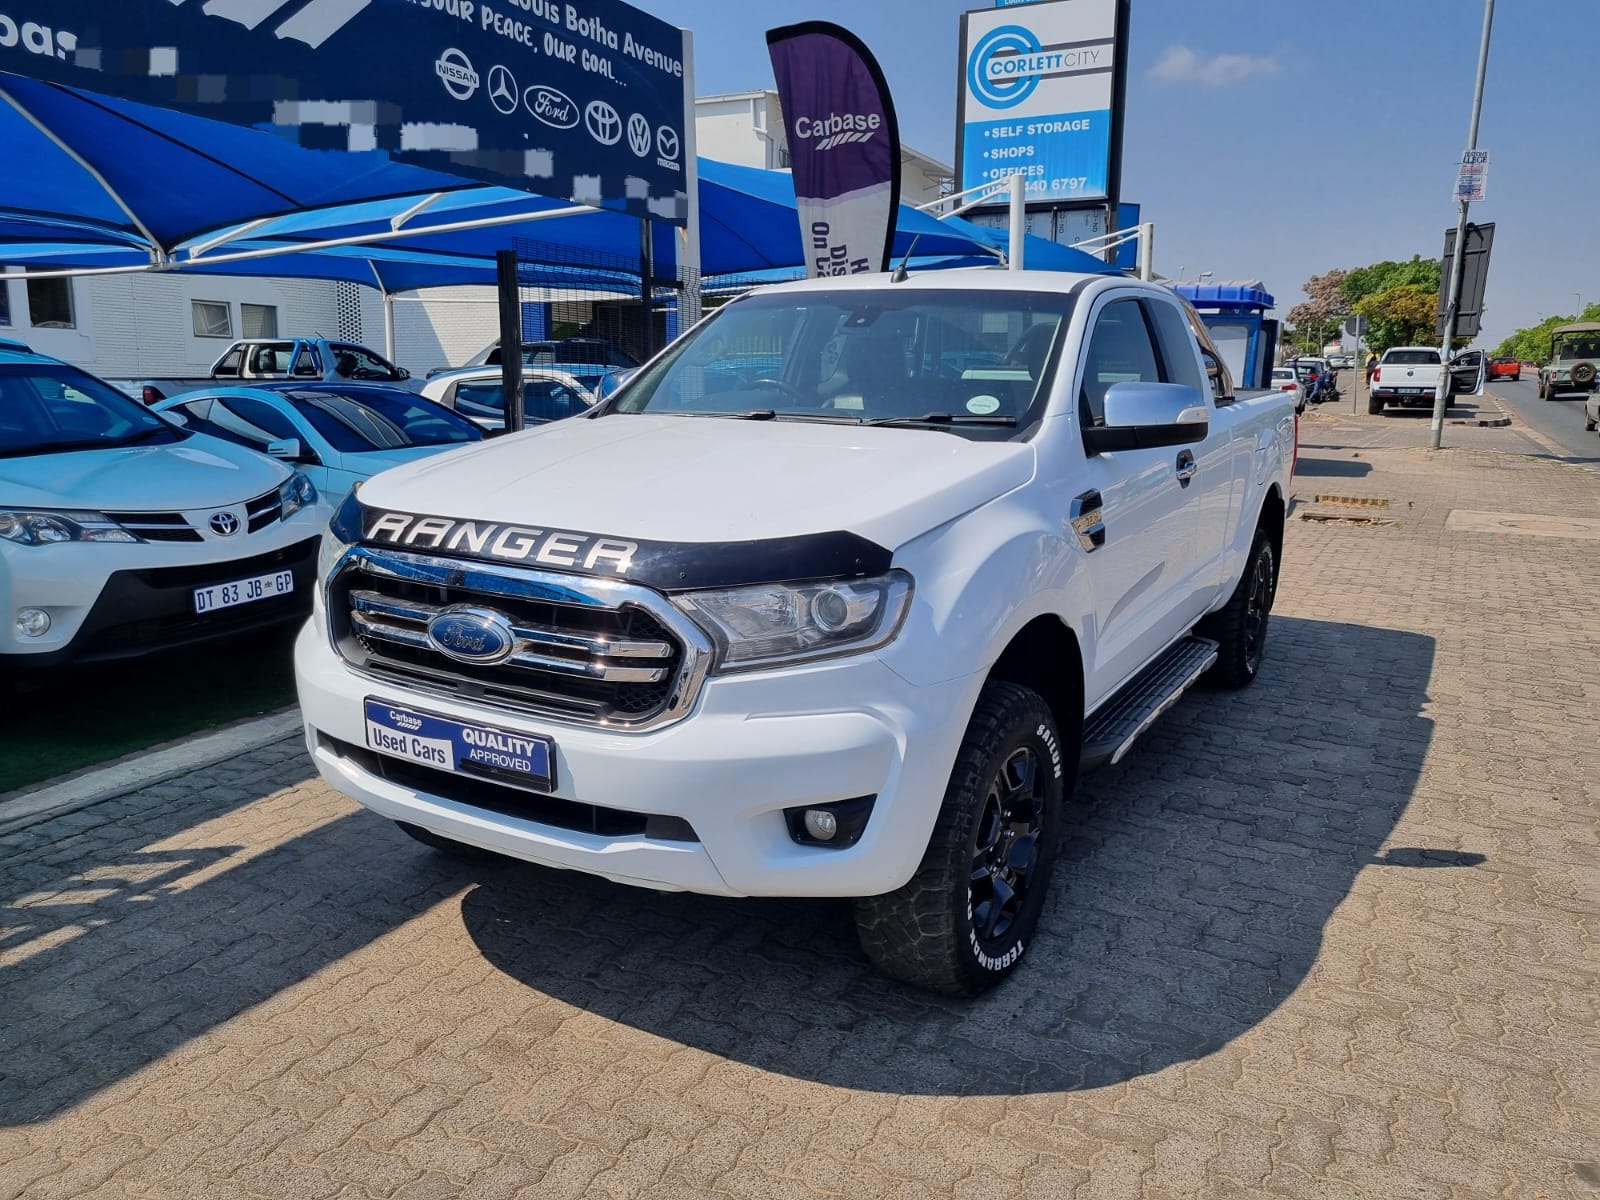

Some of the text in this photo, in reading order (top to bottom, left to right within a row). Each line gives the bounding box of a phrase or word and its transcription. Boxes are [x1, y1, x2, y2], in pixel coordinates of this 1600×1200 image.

[508, 0, 683, 78] ouis Botha Avenue
[544, 32, 577, 64] OUR
[437, 63, 478, 85] NISSAN
[535, 91, 570, 122] Ford
[795, 111, 881, 139] Carbase
[991, 119, 1091, 139] SELF STORAGE
[990, 145, 1035, 160] SHOPS
[990, 164, 1045, 179] OFFICES
[1051, 177, 1087, 191] 6797
[811, 221, 830, 250] On
[366, 512, 639, 574] RANGER
[196, 573, 292, 611] DT 83 JB GP
[443, 622, 487, 652] Ford
[389, 709, 423, 728] Carbase
[373, 727, 446, 764] Used Cars
[462, 727, 536, 757] QUALITY
[1036, 724, 1062, 779] SAILUN
[469, 748, 532, 772] APPROVED
